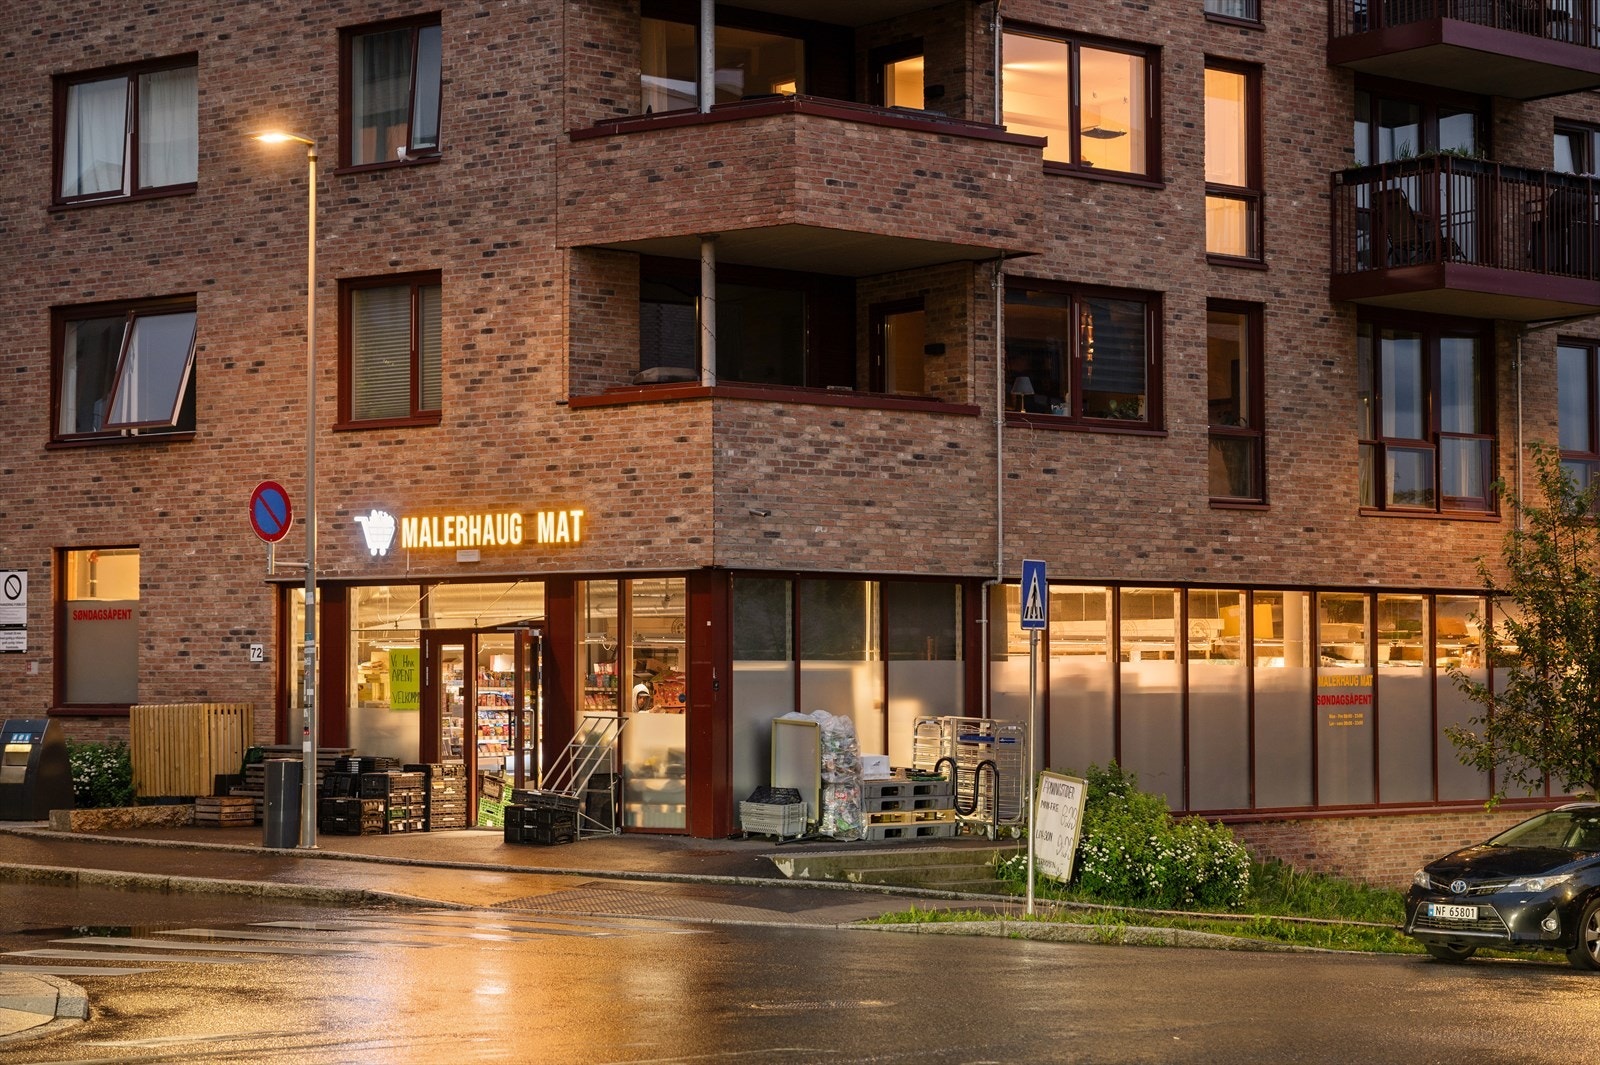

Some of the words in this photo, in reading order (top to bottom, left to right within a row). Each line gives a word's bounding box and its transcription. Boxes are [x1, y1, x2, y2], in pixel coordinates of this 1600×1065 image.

[401, 512, 523, 548] MALERHAUG
[537, 510, 584, 543] MAT
[72, 607, 132, 620] SØNDAGSÅPENT
[251, 647, 262, 659] 72
[1317, 674, 1358, 687] MALERHAUG
[1360, 674, 1373, 687] MAT
[1316, 693, 1373, 706] SØNDAGSÅPENT
[1436, 906, 1446, 915] NF
[1449, 907, 1475, 918] 65801
